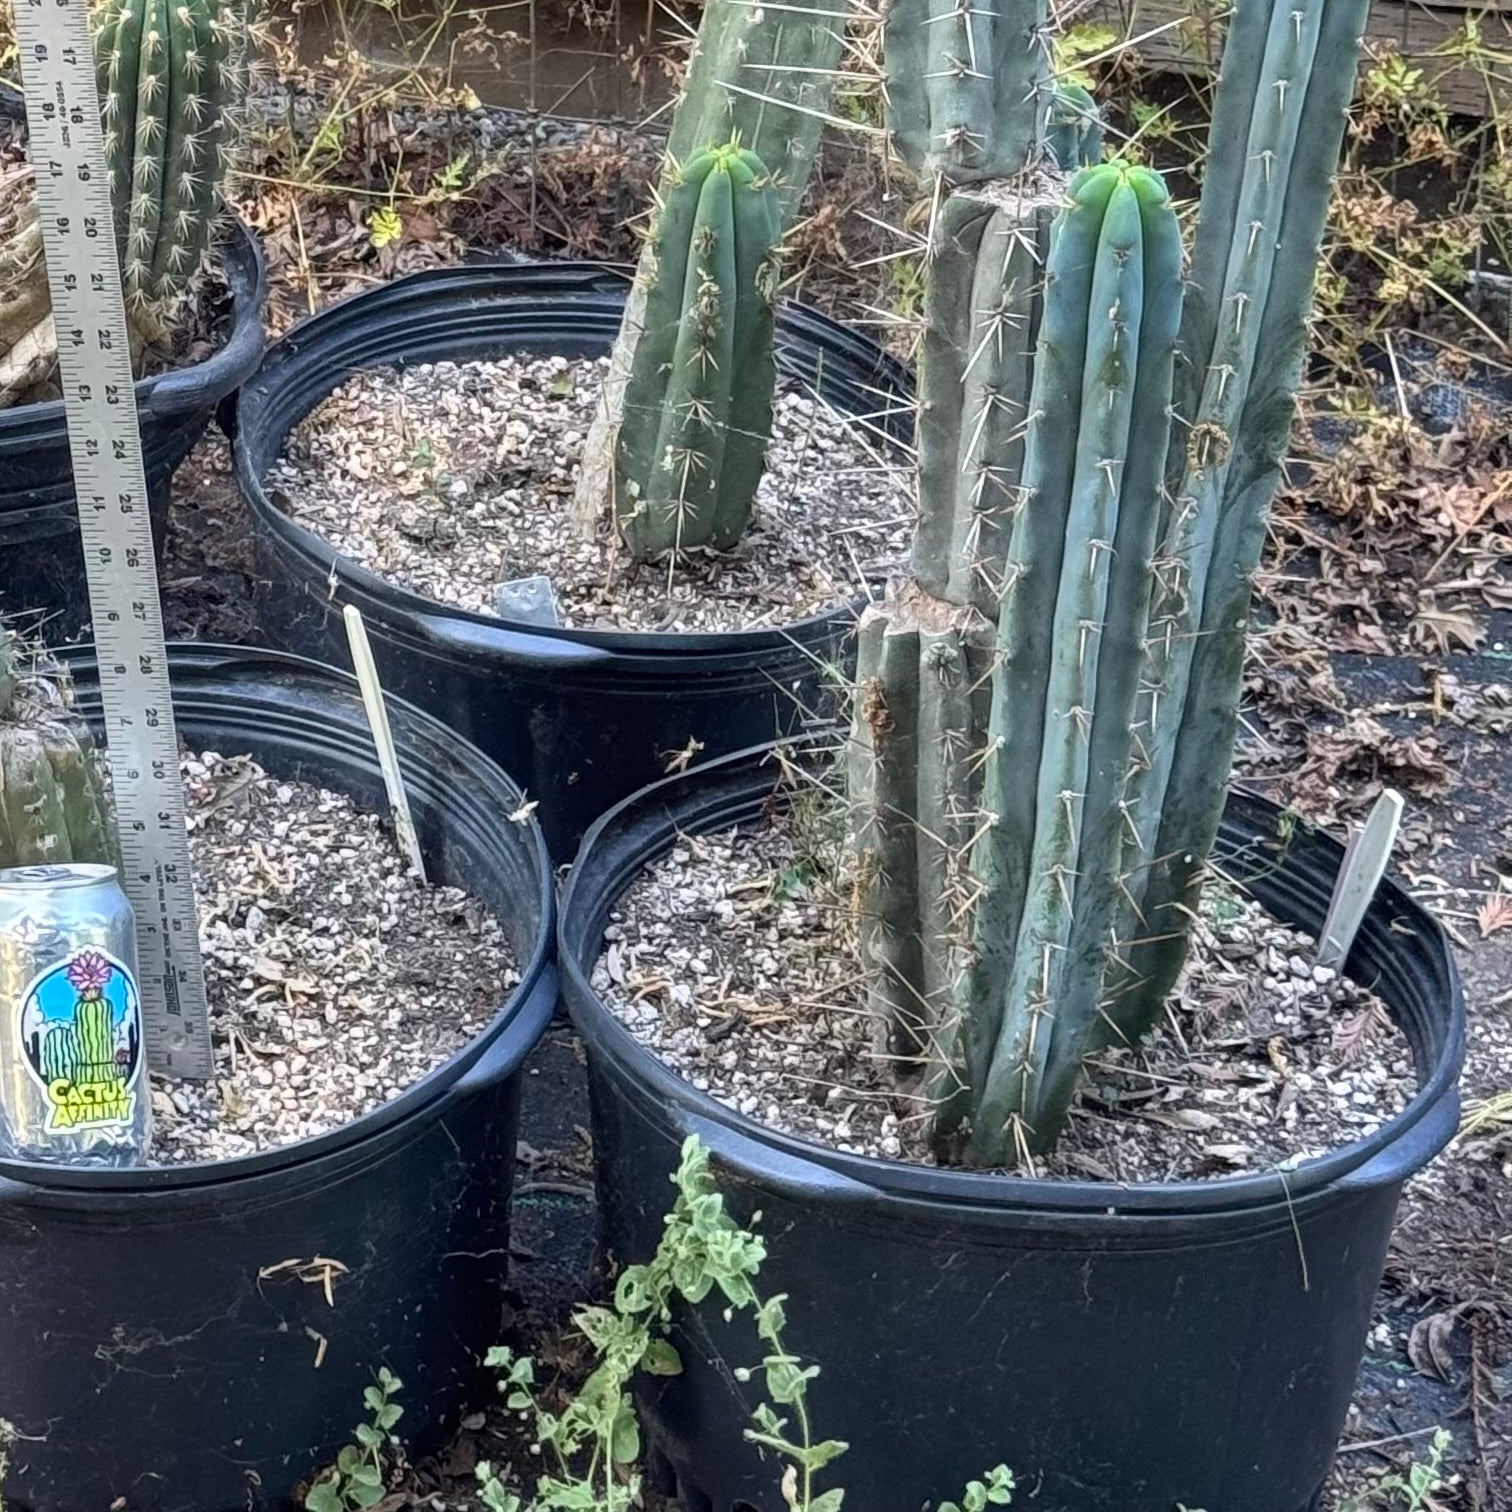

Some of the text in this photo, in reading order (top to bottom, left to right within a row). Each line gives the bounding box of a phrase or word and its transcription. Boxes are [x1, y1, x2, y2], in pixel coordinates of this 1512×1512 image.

[35, 45, 48, 63] 19
[62, 47, 77, 65] 17
[42, 103, 55, 121] 18
[70, 106, 83, 124] 18
[49, 161, 63, 177] 17
[77, 164, 91, 182] 19
[57, 218, 70, 236] 16
[84, 217, 98, 238] 20
[64, 274, 77, 291] 15
[91, 273, 104, 292] 21
[71, 329, 85, 347] 14
[98, 330, 112, 350] 22
[79, 385, 92, 402] 13
[105, 385, 120, 405] 23
[86, 439, 99, 456] 12
[112, 440, 127, 459] 24
[92, 496, 106, 512] 11
[119, 494, 134, 514] 25
[99, 548, 112, 564] 10
[126, 548, 139, 567] 26
[107, 612, 120, 621] 9
[133, 602, 147, 621] 27
[114, 666, 126, 674] 8
[139, 655, 153, 675] 28
[121, 719, 133, 727] 7
[145, 708, 159, 727] 29
[127, 770, 139, 780] 6
[152, 760, 165, 779] 30
[133, 822, 146, 831] 5
[158, 812, 171, 829] 31
[139, 874, 152, 883] 4
[164, 864, 178, 884] 32
[163, 975, 181, 1017] JOHNSON
[48, 1077, 127, 1106] CACTUS
[50, 1098, 132, 1128] AFFINITY
